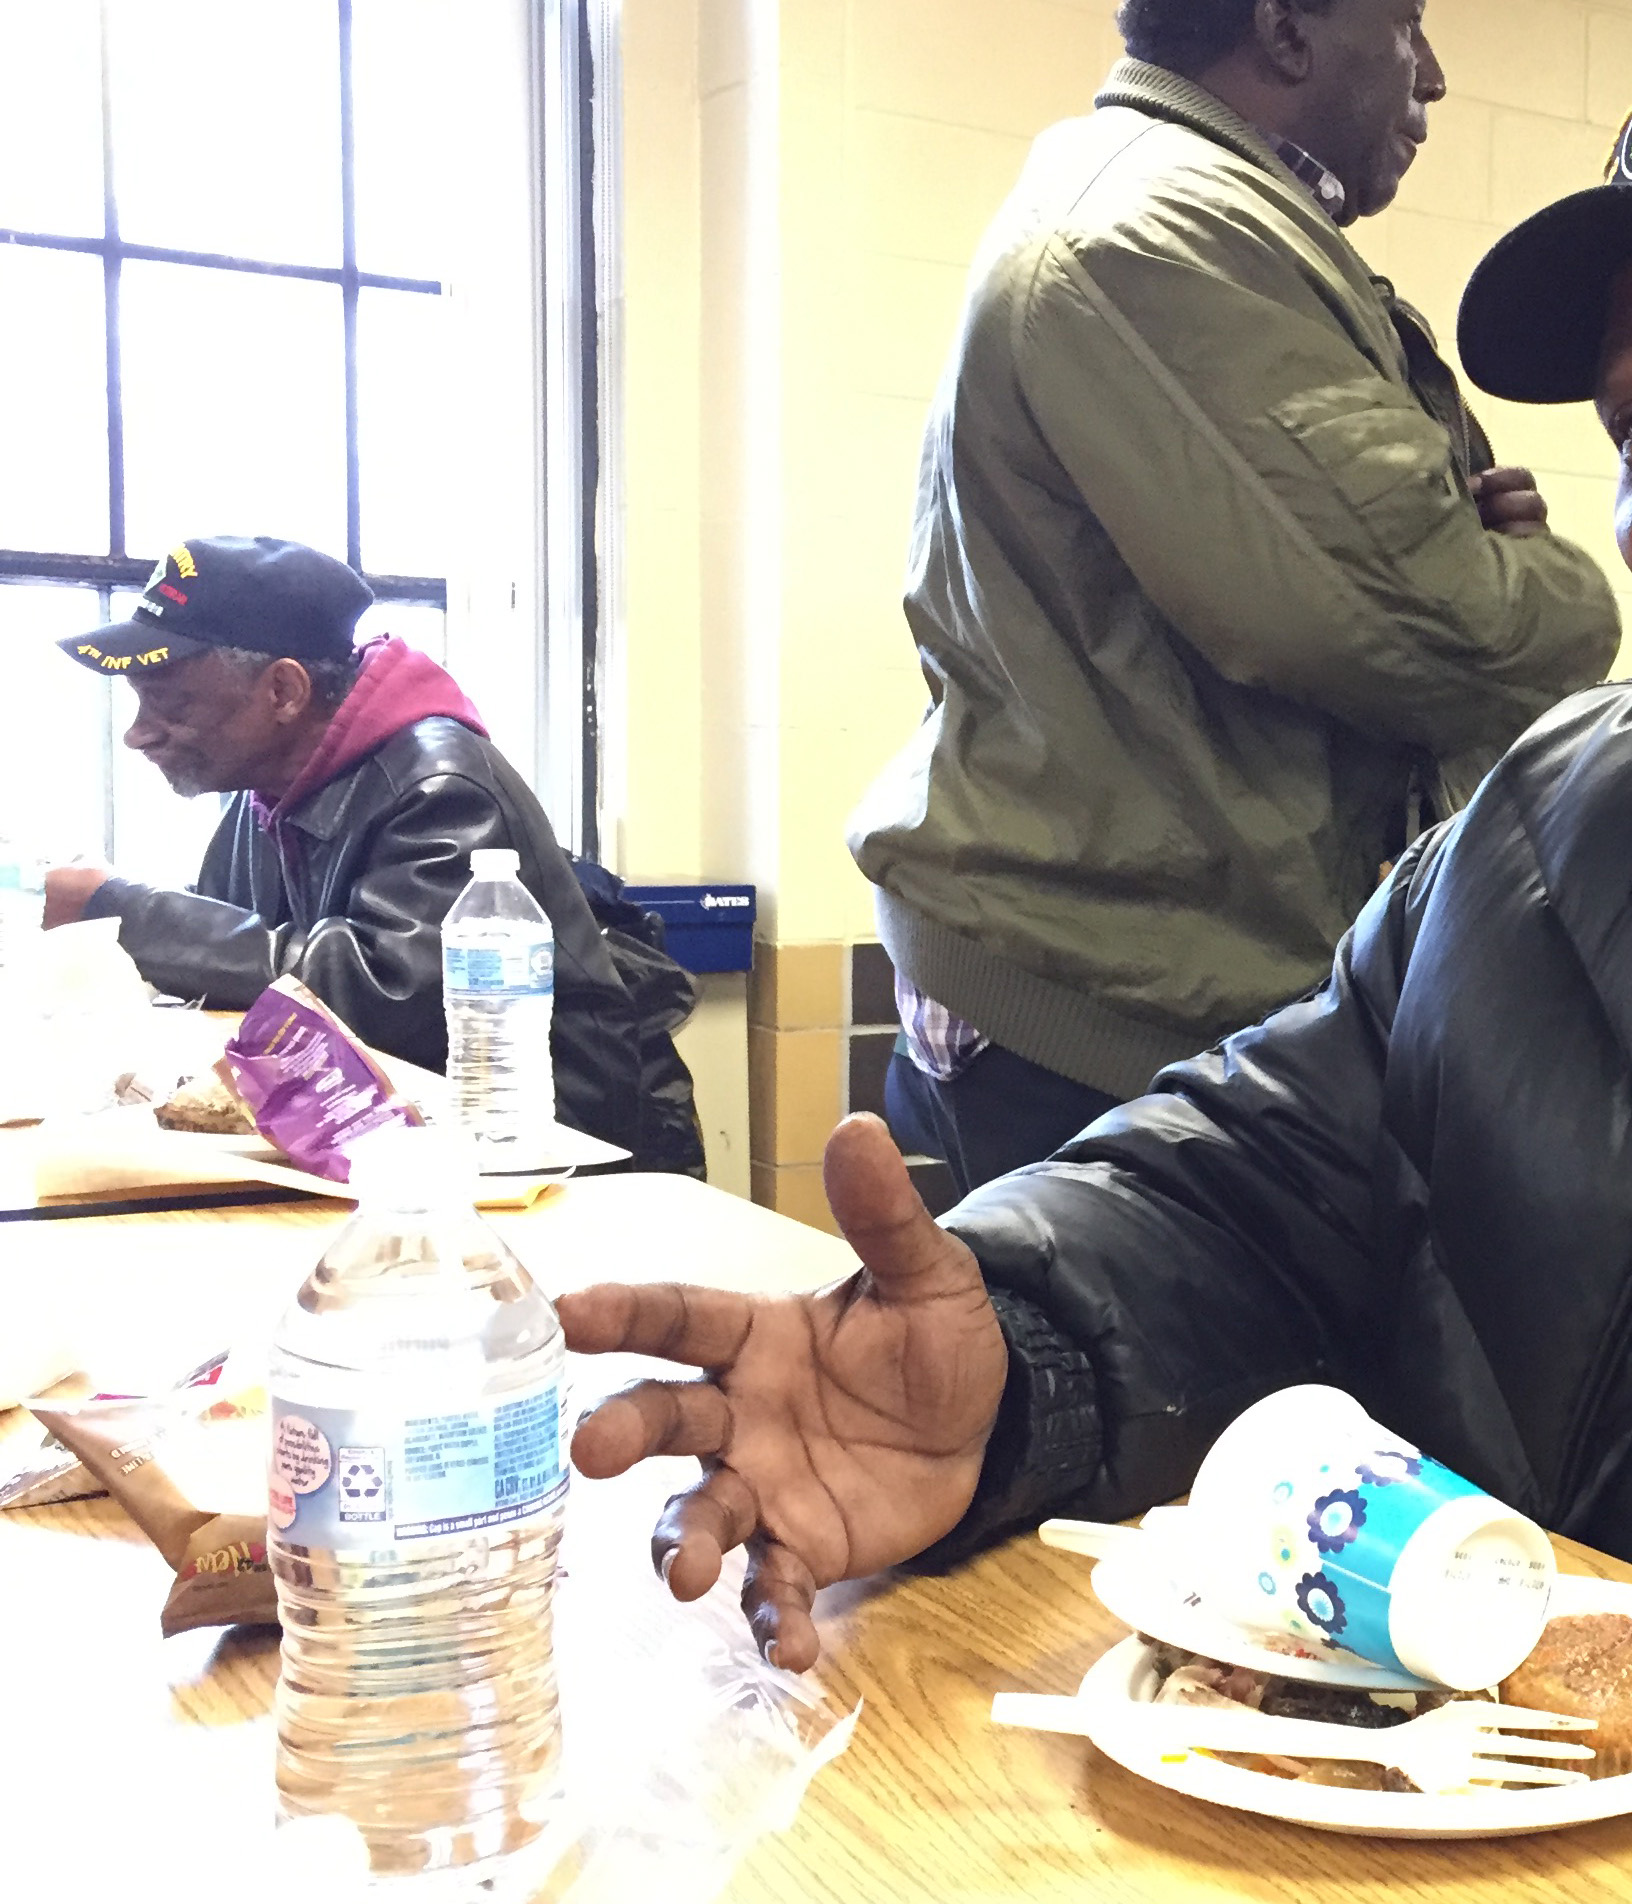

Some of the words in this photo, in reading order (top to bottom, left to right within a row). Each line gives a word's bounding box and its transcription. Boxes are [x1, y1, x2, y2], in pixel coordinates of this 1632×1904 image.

[101, 655, 132, 669] INF
[136, 647, 169, 665] VET
[344, 1512, 382, 1521] BOTTLE
[455, 1517, 473, 1530] small
[487, 1512, 499, 1525] and
